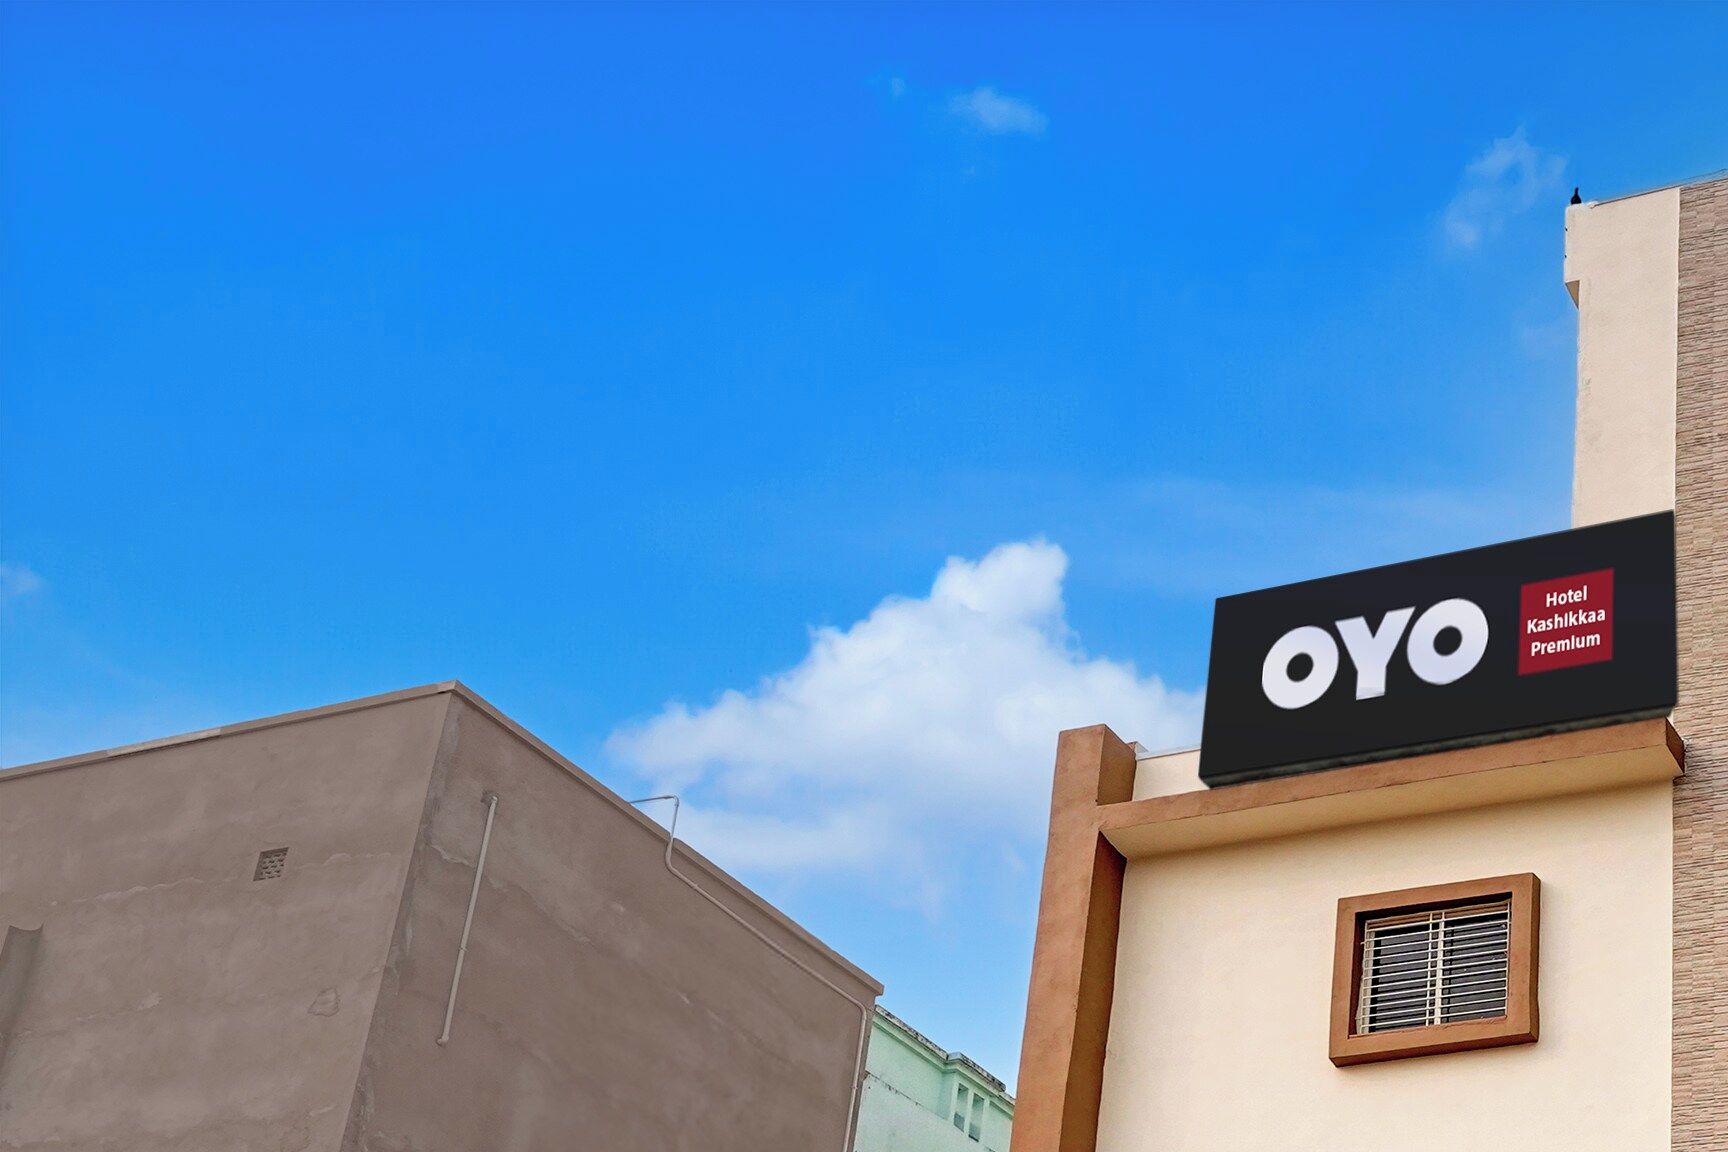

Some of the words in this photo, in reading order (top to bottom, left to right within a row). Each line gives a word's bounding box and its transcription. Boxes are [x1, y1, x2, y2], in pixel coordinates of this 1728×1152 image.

[1545, 584, 1588, 608] Hotel
[1526, 608, 1607, 634] Kashikkaa
[1261, 597, 1490, 710] OYO
[1530, 632, 1601, 657] Premium
